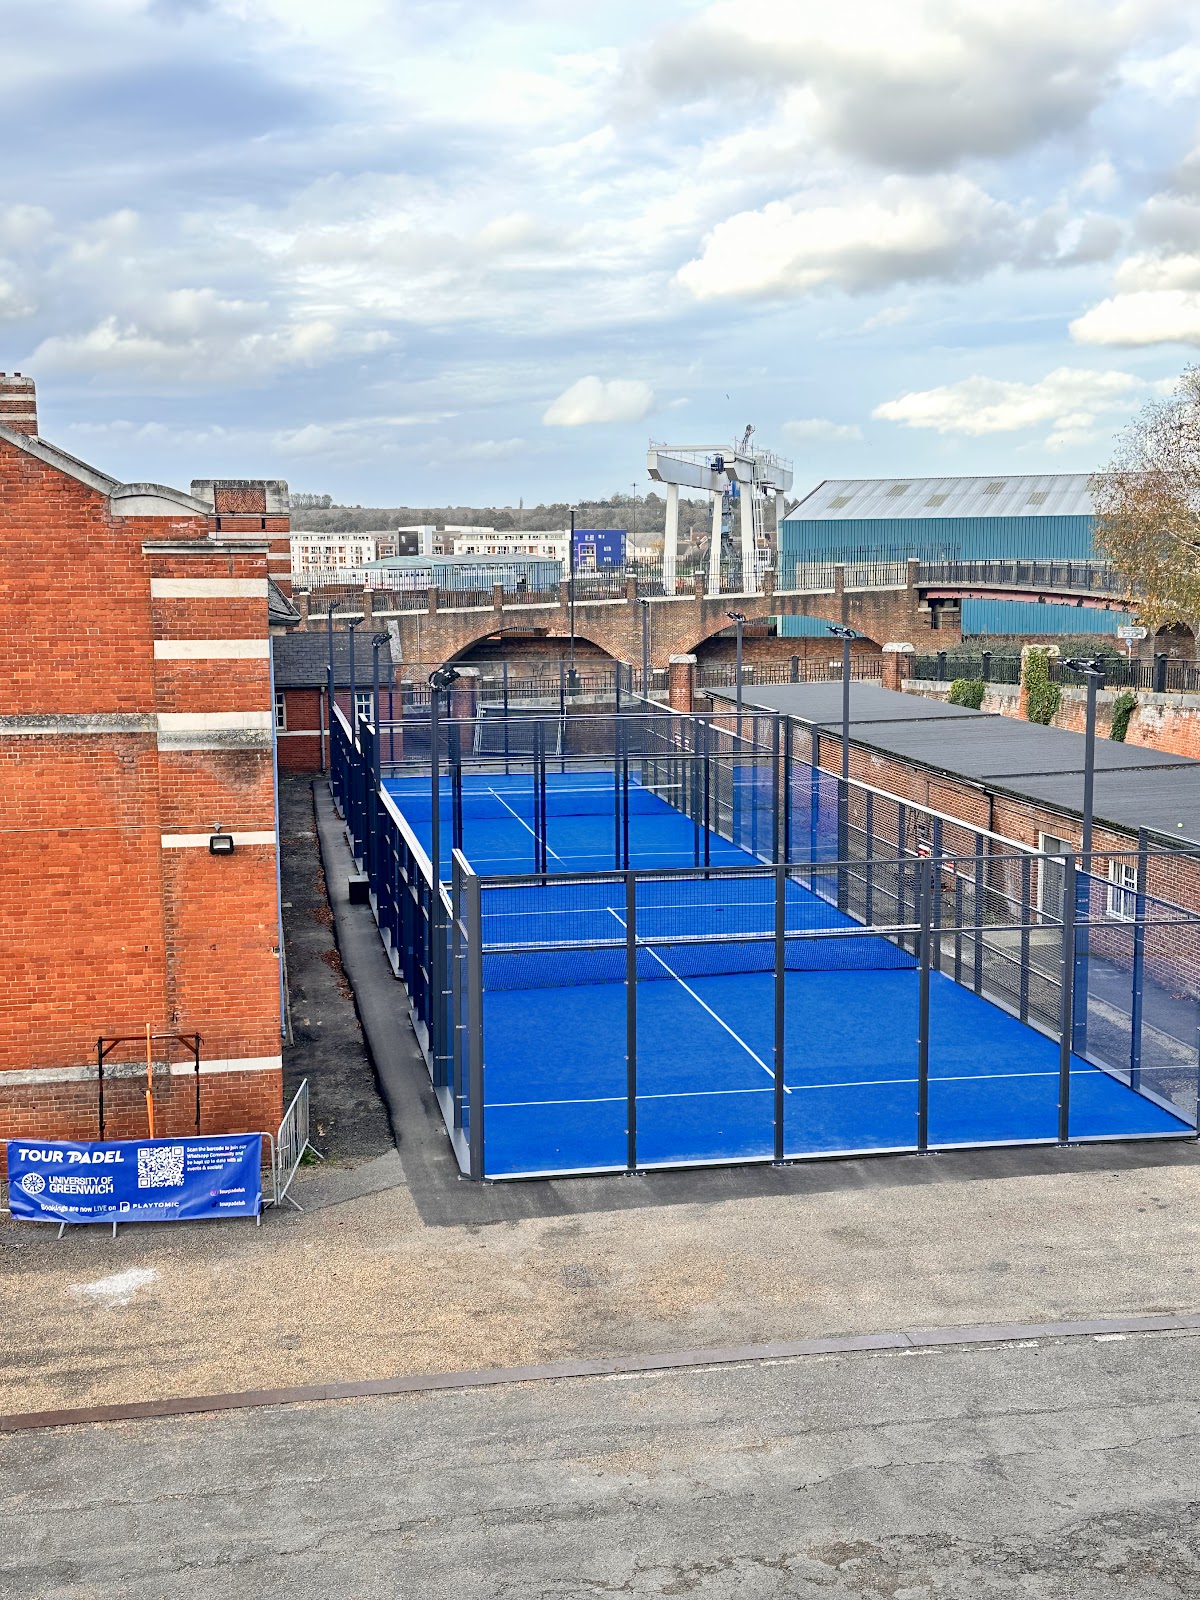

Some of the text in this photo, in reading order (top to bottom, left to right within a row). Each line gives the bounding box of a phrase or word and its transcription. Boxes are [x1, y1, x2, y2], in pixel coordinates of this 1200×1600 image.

[18, 1148, 125, 1164] TOUR PADEL
[48, 1175, 113, 1185] UNIVERSITY OF
[49, 1184, 114, 1194] GREENWICH
[40, 1203, 68, 1212] Bookings
